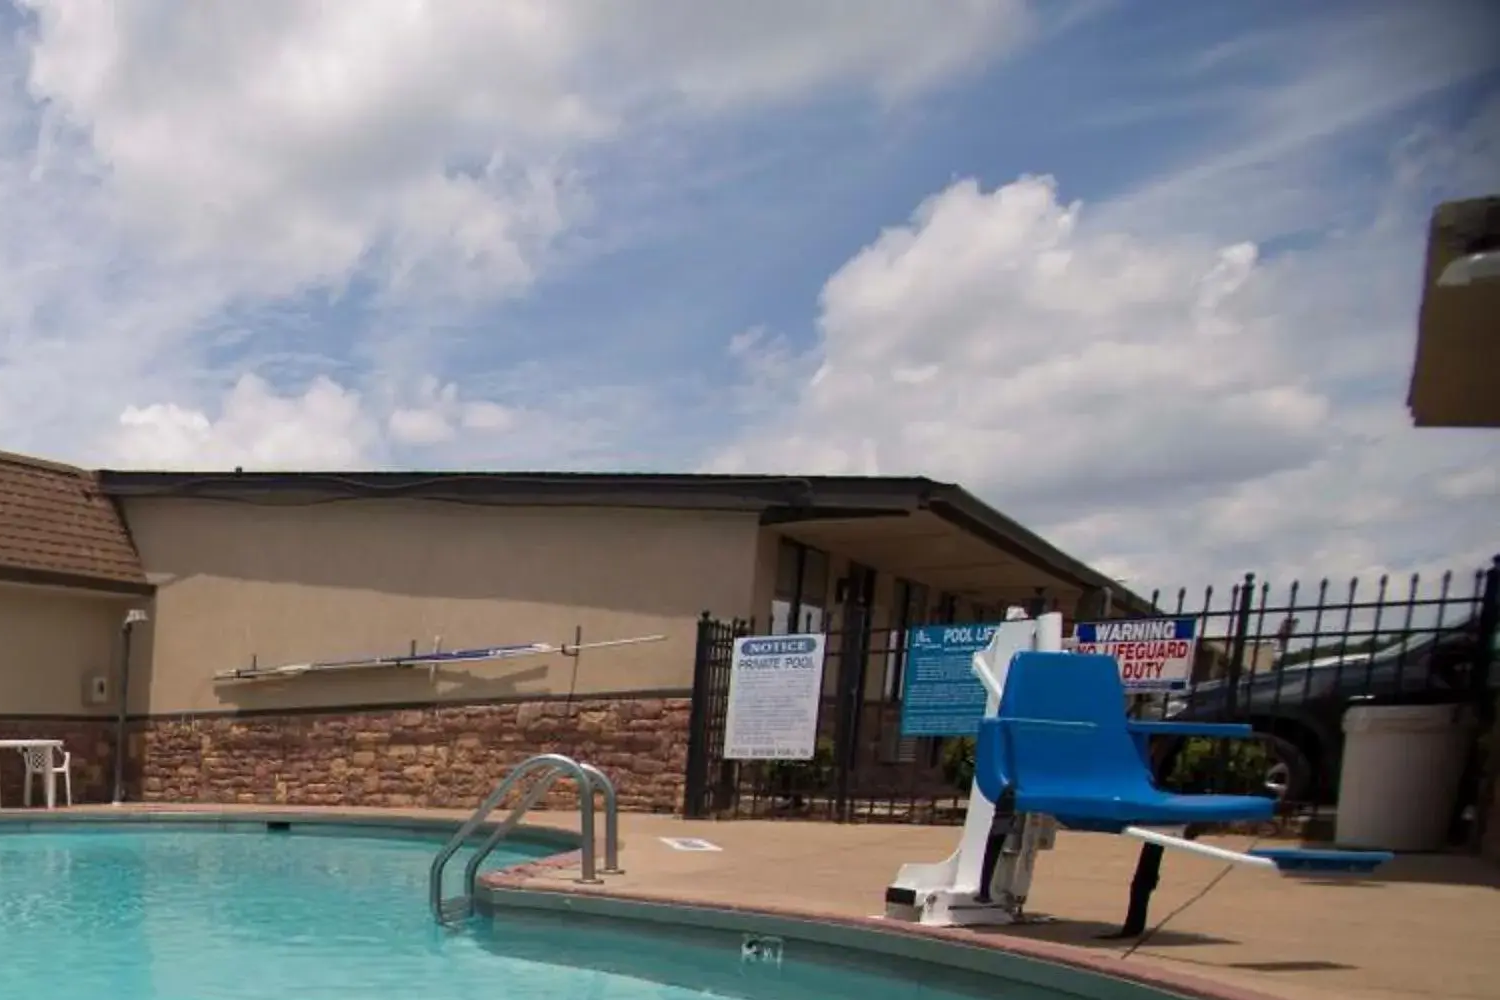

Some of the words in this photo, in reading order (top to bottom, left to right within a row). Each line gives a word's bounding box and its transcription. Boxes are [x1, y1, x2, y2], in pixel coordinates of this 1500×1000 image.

[944, 628, 973, 643] POOL
[976, 627, 997, 641] LIF
[1095, 621, 1176, 642] WARNING
[749, 640, 807, 653] NOTICE
[738, 657, 781, 670] PRIVATE
[785, 656, 815, 669] POOL
[1122, 661, 1166, 679] DUTY
